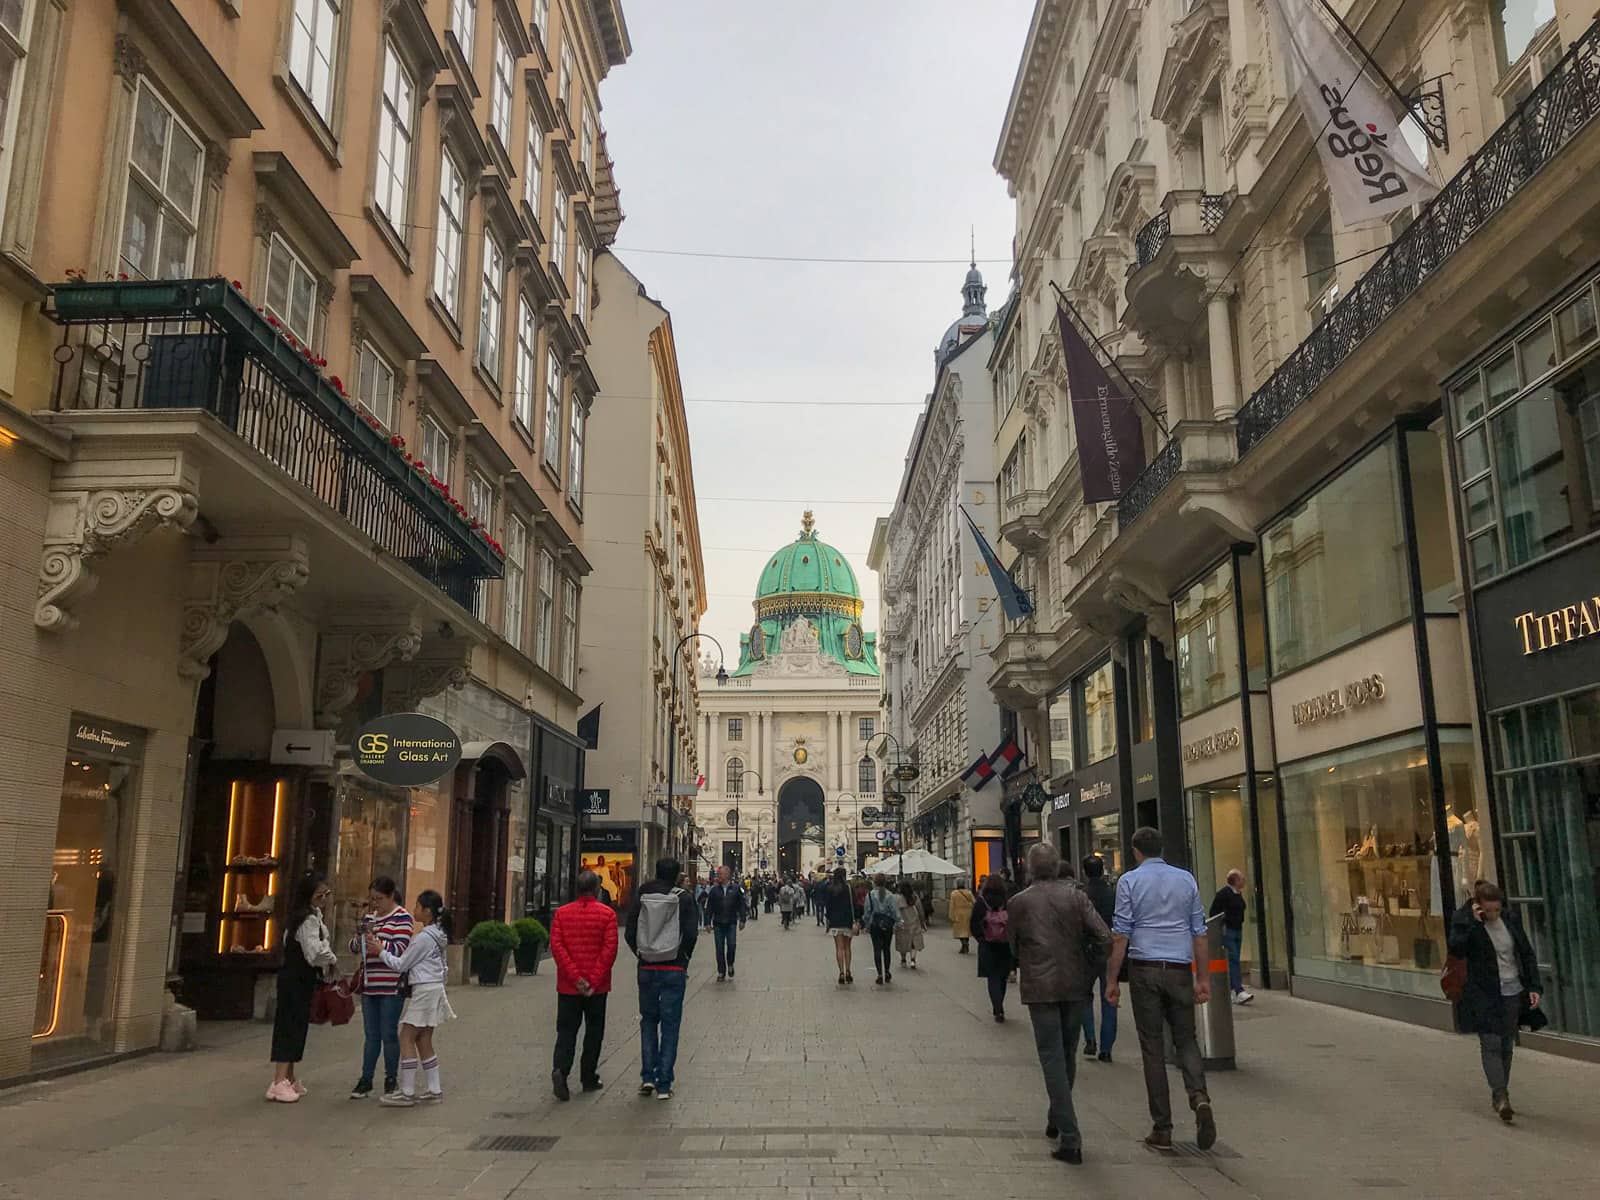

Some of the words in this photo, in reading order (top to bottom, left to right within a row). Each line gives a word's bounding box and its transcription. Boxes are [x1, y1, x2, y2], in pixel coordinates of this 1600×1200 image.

[358, 733, 389, 754] GS
[393, 738, 455, 749] International
[399, 751, 429, 762] Glass
[432, 752, 449, 762] Art
